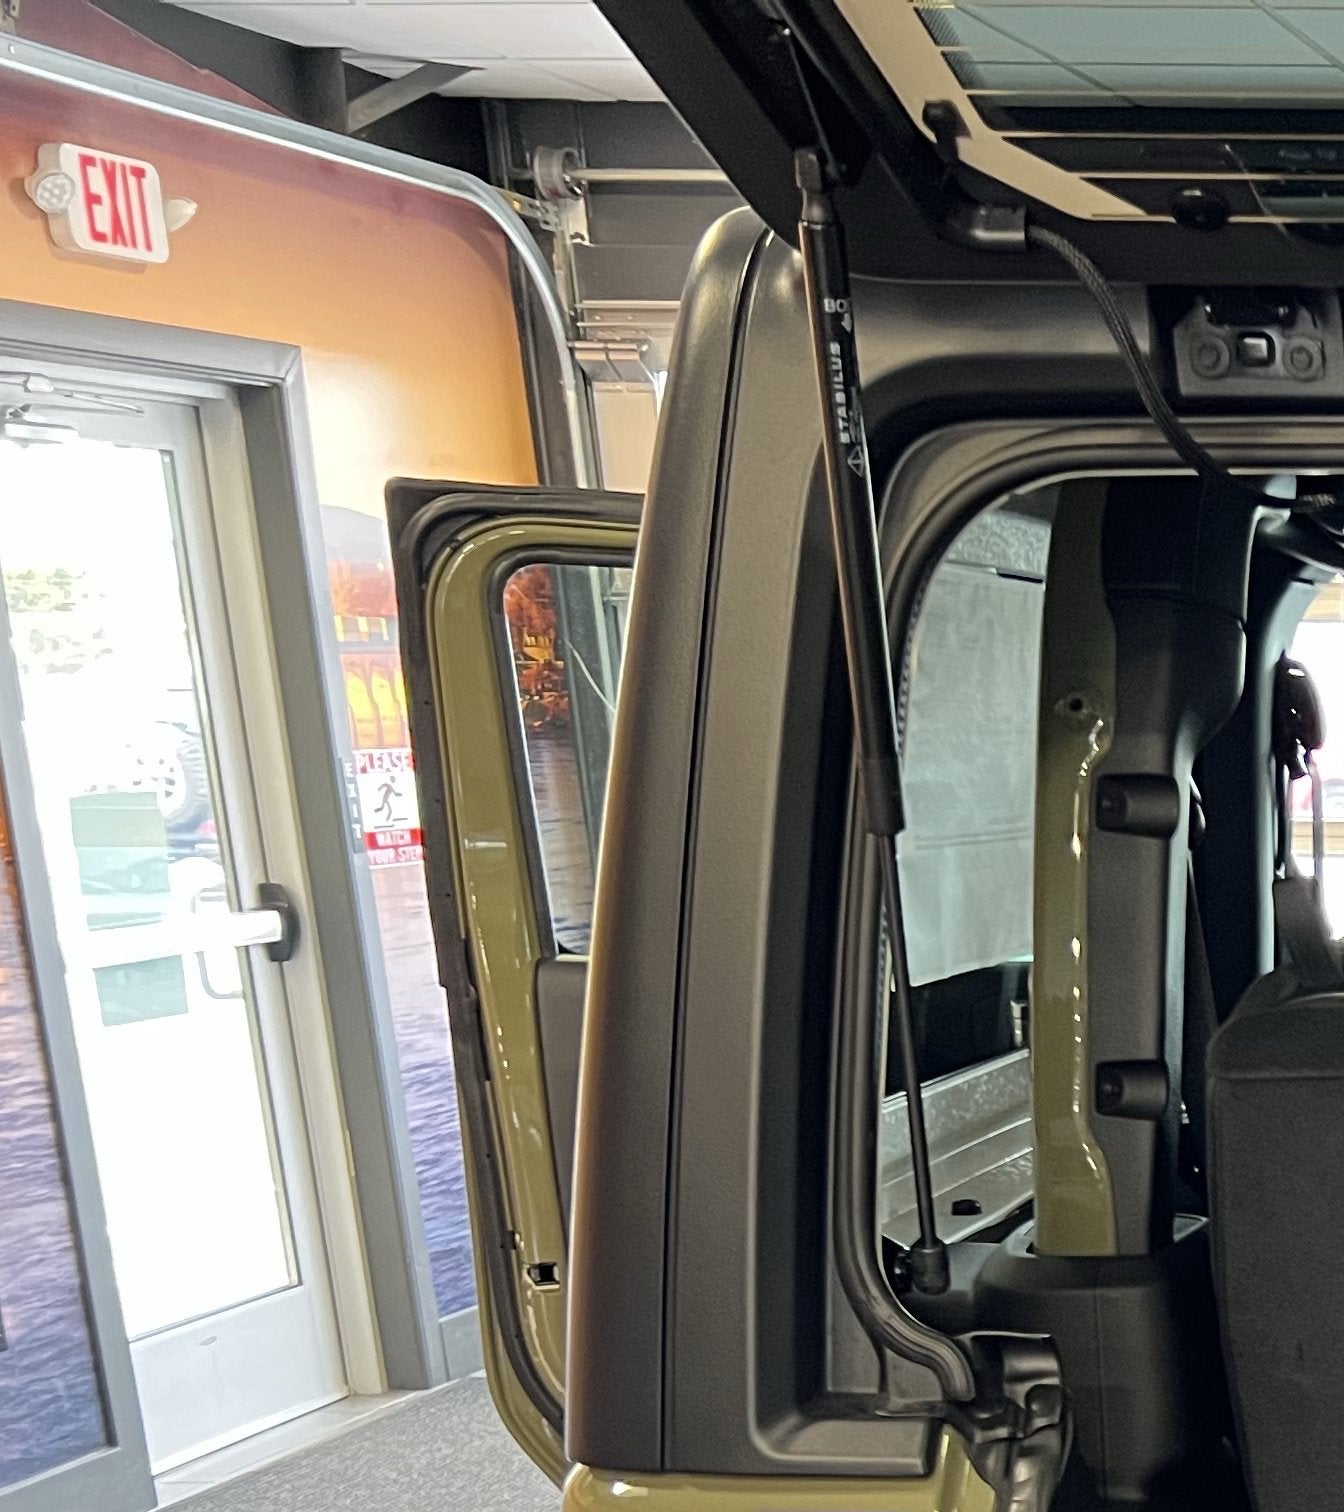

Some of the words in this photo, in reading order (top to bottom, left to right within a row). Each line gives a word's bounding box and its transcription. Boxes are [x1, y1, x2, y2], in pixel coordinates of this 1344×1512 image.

[77, 152, 153, 253] EXIT
[829, 341, 851, 444] STABILUS
[355, 752, 411, 773] PLEASE
[375, 830, 412, 847] WATCH
